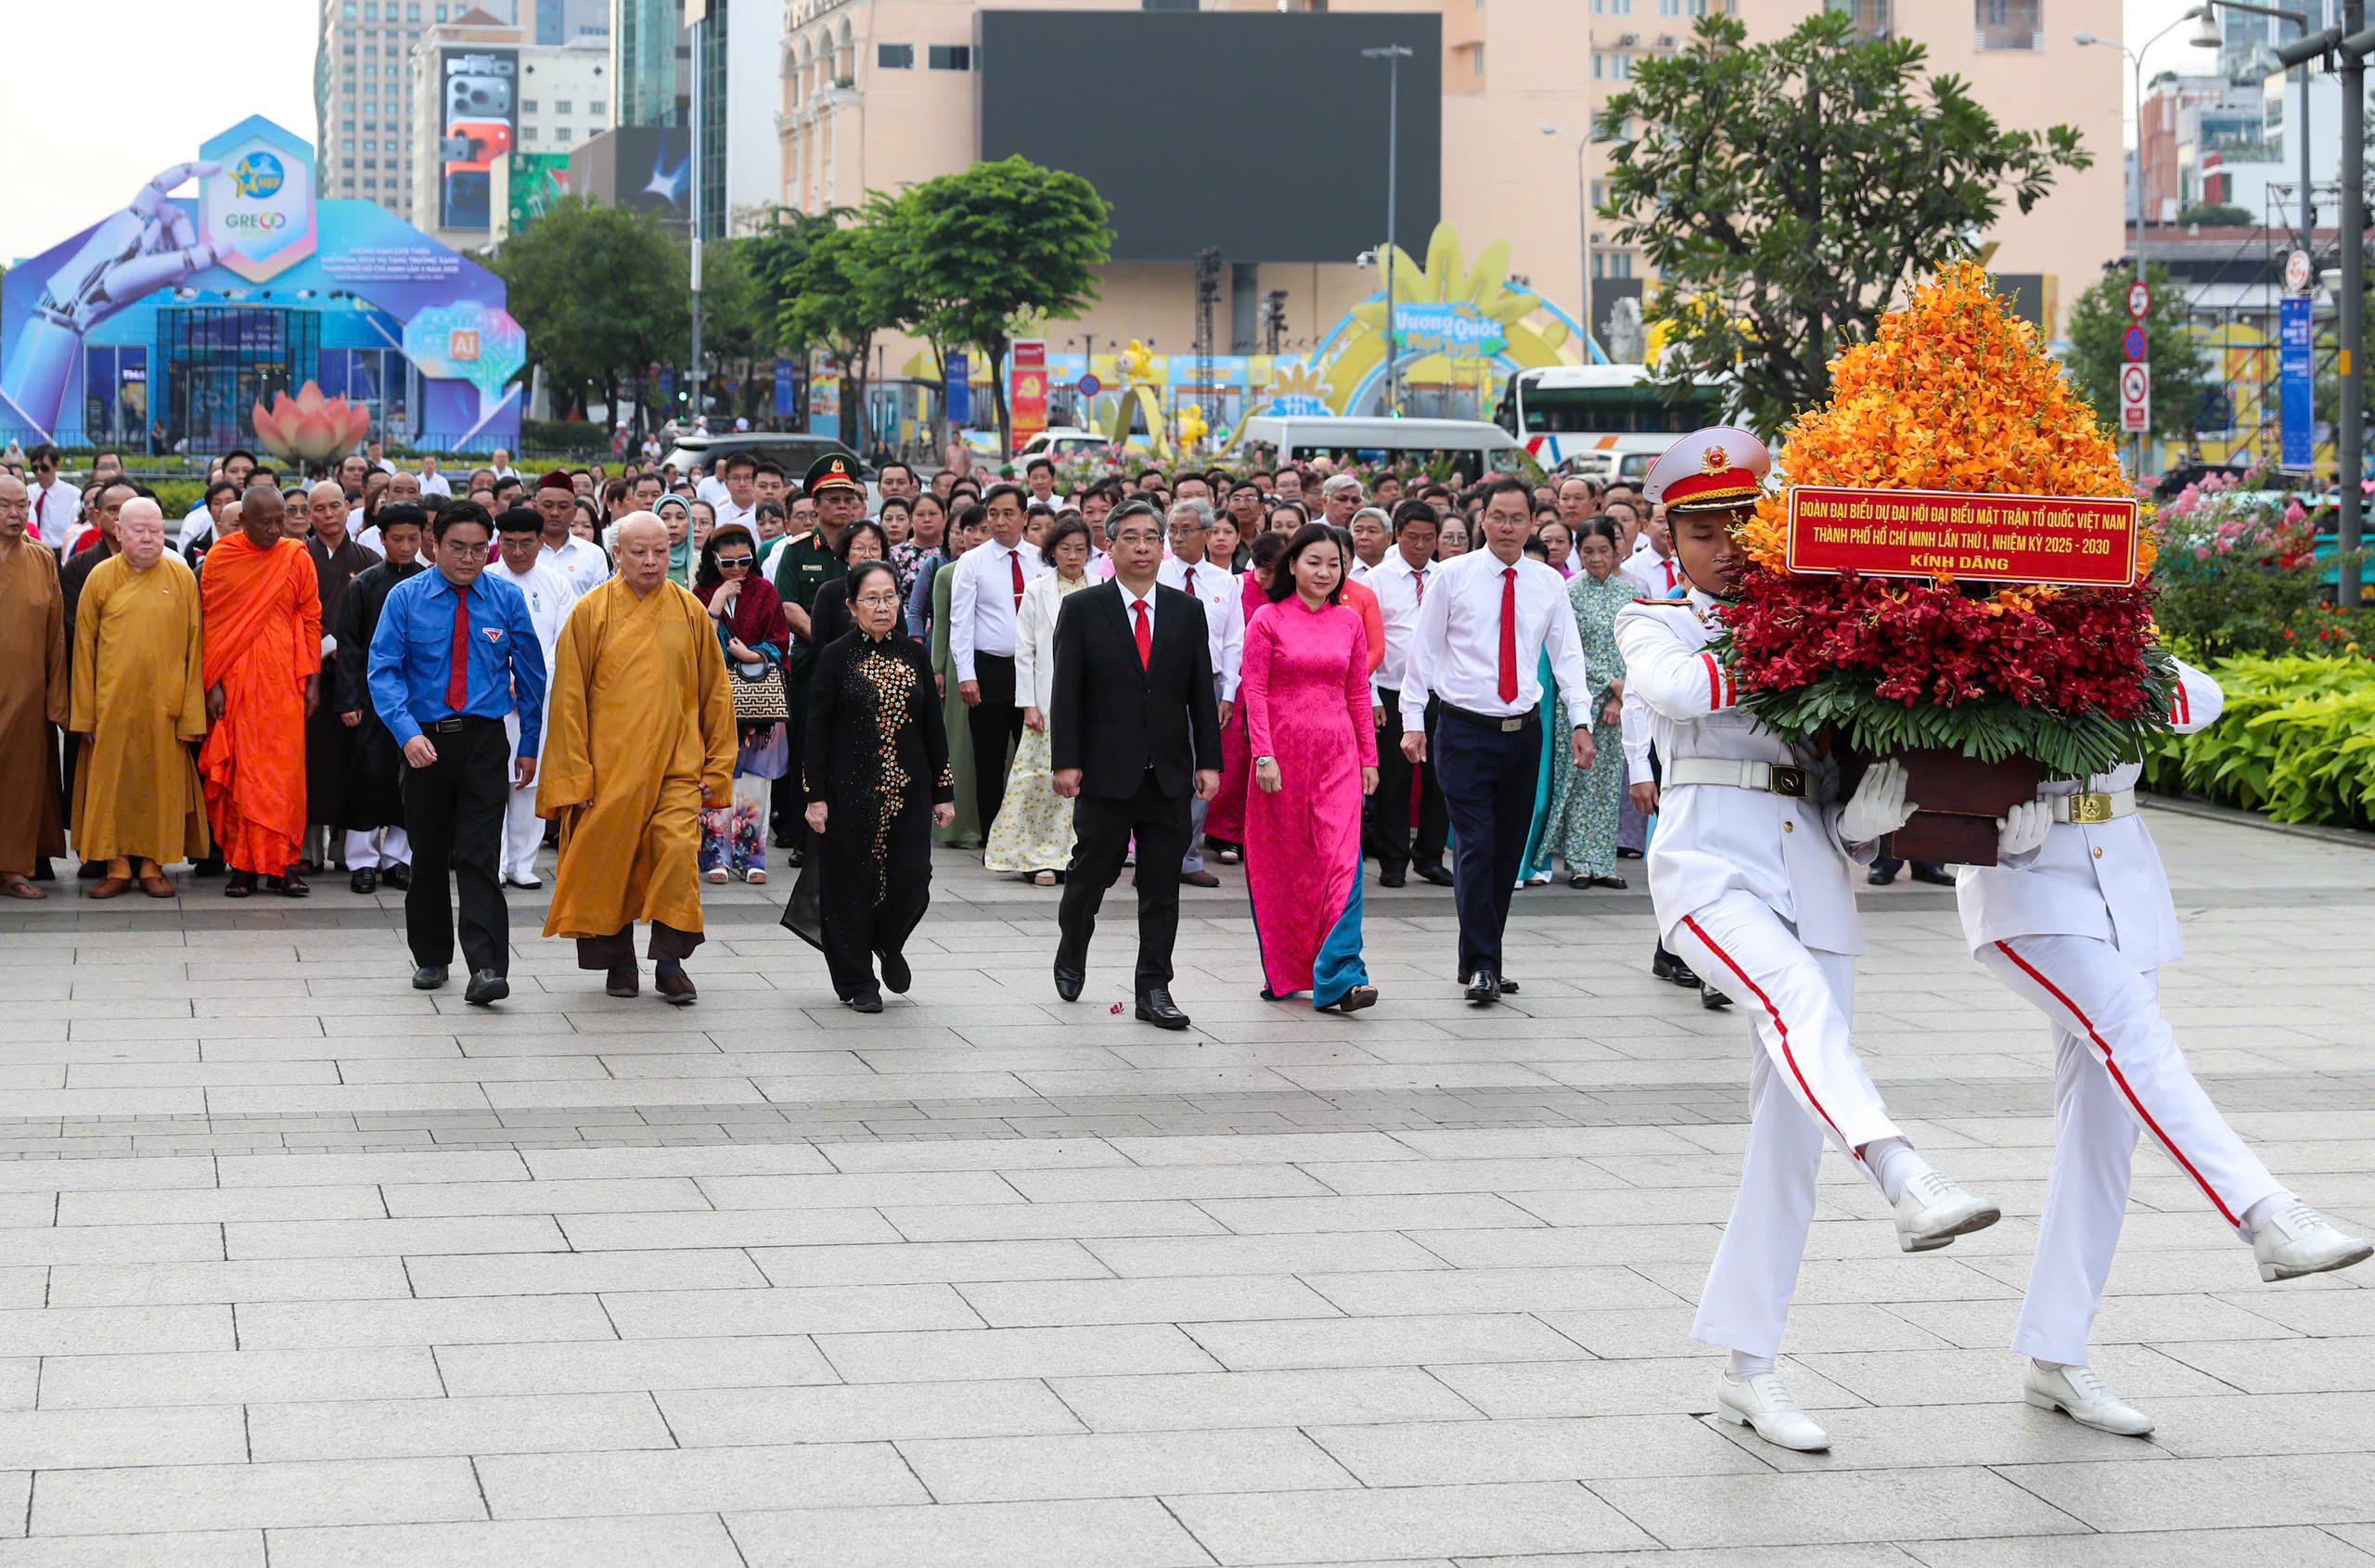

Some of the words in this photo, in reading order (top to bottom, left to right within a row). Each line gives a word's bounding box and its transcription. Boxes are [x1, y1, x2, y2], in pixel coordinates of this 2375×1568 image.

[225, 211, 286, 230] GRECO
[1395, 311, 1454, 337] Vương
[1455, 316, 1503, 340] Quốc
[455, 335, 476, 354] AI
[1800, 499, 1828, 518] ĐOÀN
[1829, 503, 1847, 521] ĐẠI
[1850, 498, 1873, 520] BIỂU
[1876, 505, 1890, 523] DỰ
[1892, 505, 1909, 524] ĐẠI
[1911, 504, 1929, 525] HỘI
[1931, 507, 1948, 526] ĐẠI
[1951, 502, 1974, 524] BIỂU
[1976, 506, 1999, 528] MẶT
[2002, 508, 2030, 529] TRẬN
[2032, 505, 2047, 527] TỔ
[2047, 508, 2074, 529] QUỐC
[2077, 511, 2100, 533] VIỆT
[2102, 514, 2126, 531] NAM
[1813, 524, 1848, 544] THÀNH
[1850, 524, 1872, 545] PHỐ
[1873, 525, 1888, 546] HỒ
[1889, 528, 1906, 546] CHÍ
[1908, 531, 1936, 547] MINH
[1938, 528, 1958, 548] LẦN
[1961, 531, 1982, 549] THỨ
[1983, 534, 1990, 551] I,
[1992, 533, 2026, 554] NHIỆM
[2028, 533, 2043, 552] KỲ
[2045, 536, 2073, 554] 2025
[2082, 538, 2110, 555] 2030
[1910, 552, 1955, 568] KÍNH
[1959, 555, 2009, 571] DÂNG
